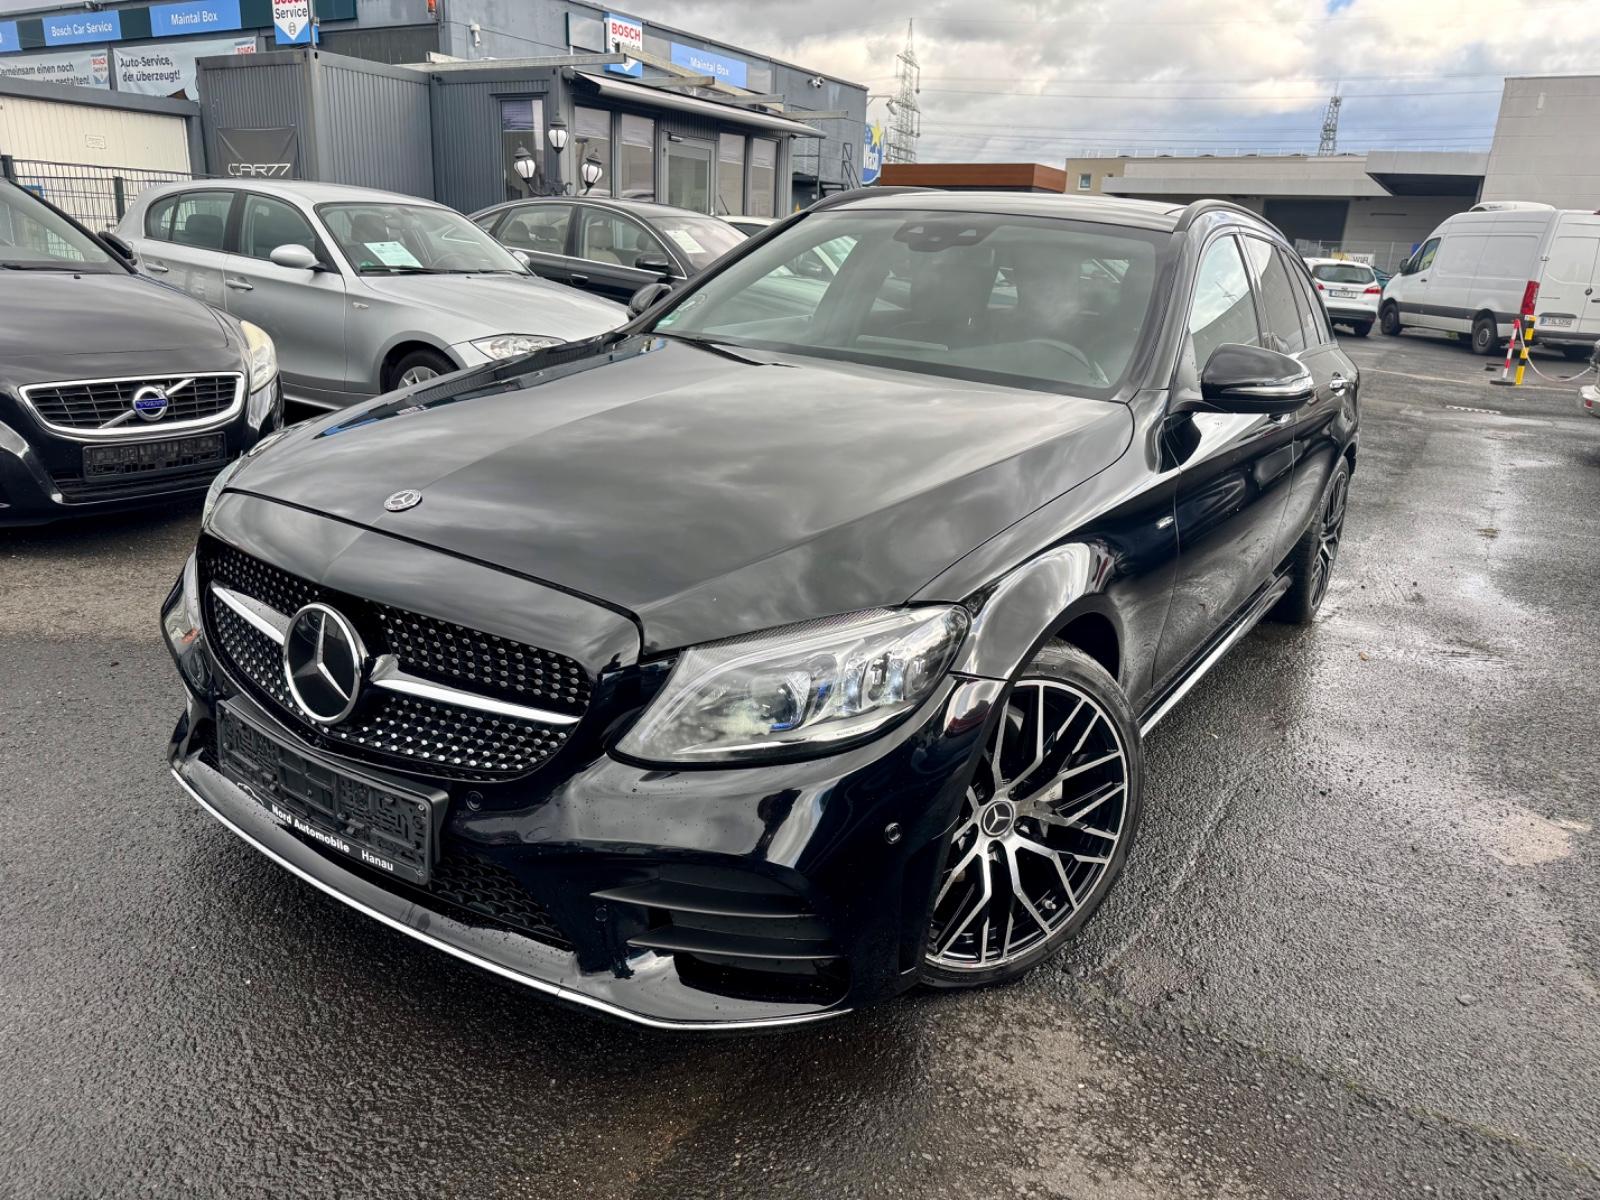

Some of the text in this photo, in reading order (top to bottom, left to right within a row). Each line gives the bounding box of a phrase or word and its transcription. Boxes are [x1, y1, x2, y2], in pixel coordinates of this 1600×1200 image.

[171, 10, 218, 25] Maintal Box
[275, 6, 308, 19] Service
[51, 21, 113, 37] Bosch Car Service
[612, 23, 640, 40] BOSCH
[37, 63, 55, 74] einen
[57, 62, 74, 73] noch
[120, 55, 173, 68] Auto-Service,
[690, 57, 729, 76] Maintal Box
[137, 69, 181, 84] überzeugt!
[228, 163, 291, 177] CAR77
[271, 804, 394, 871] Nord Automobile Hanau
